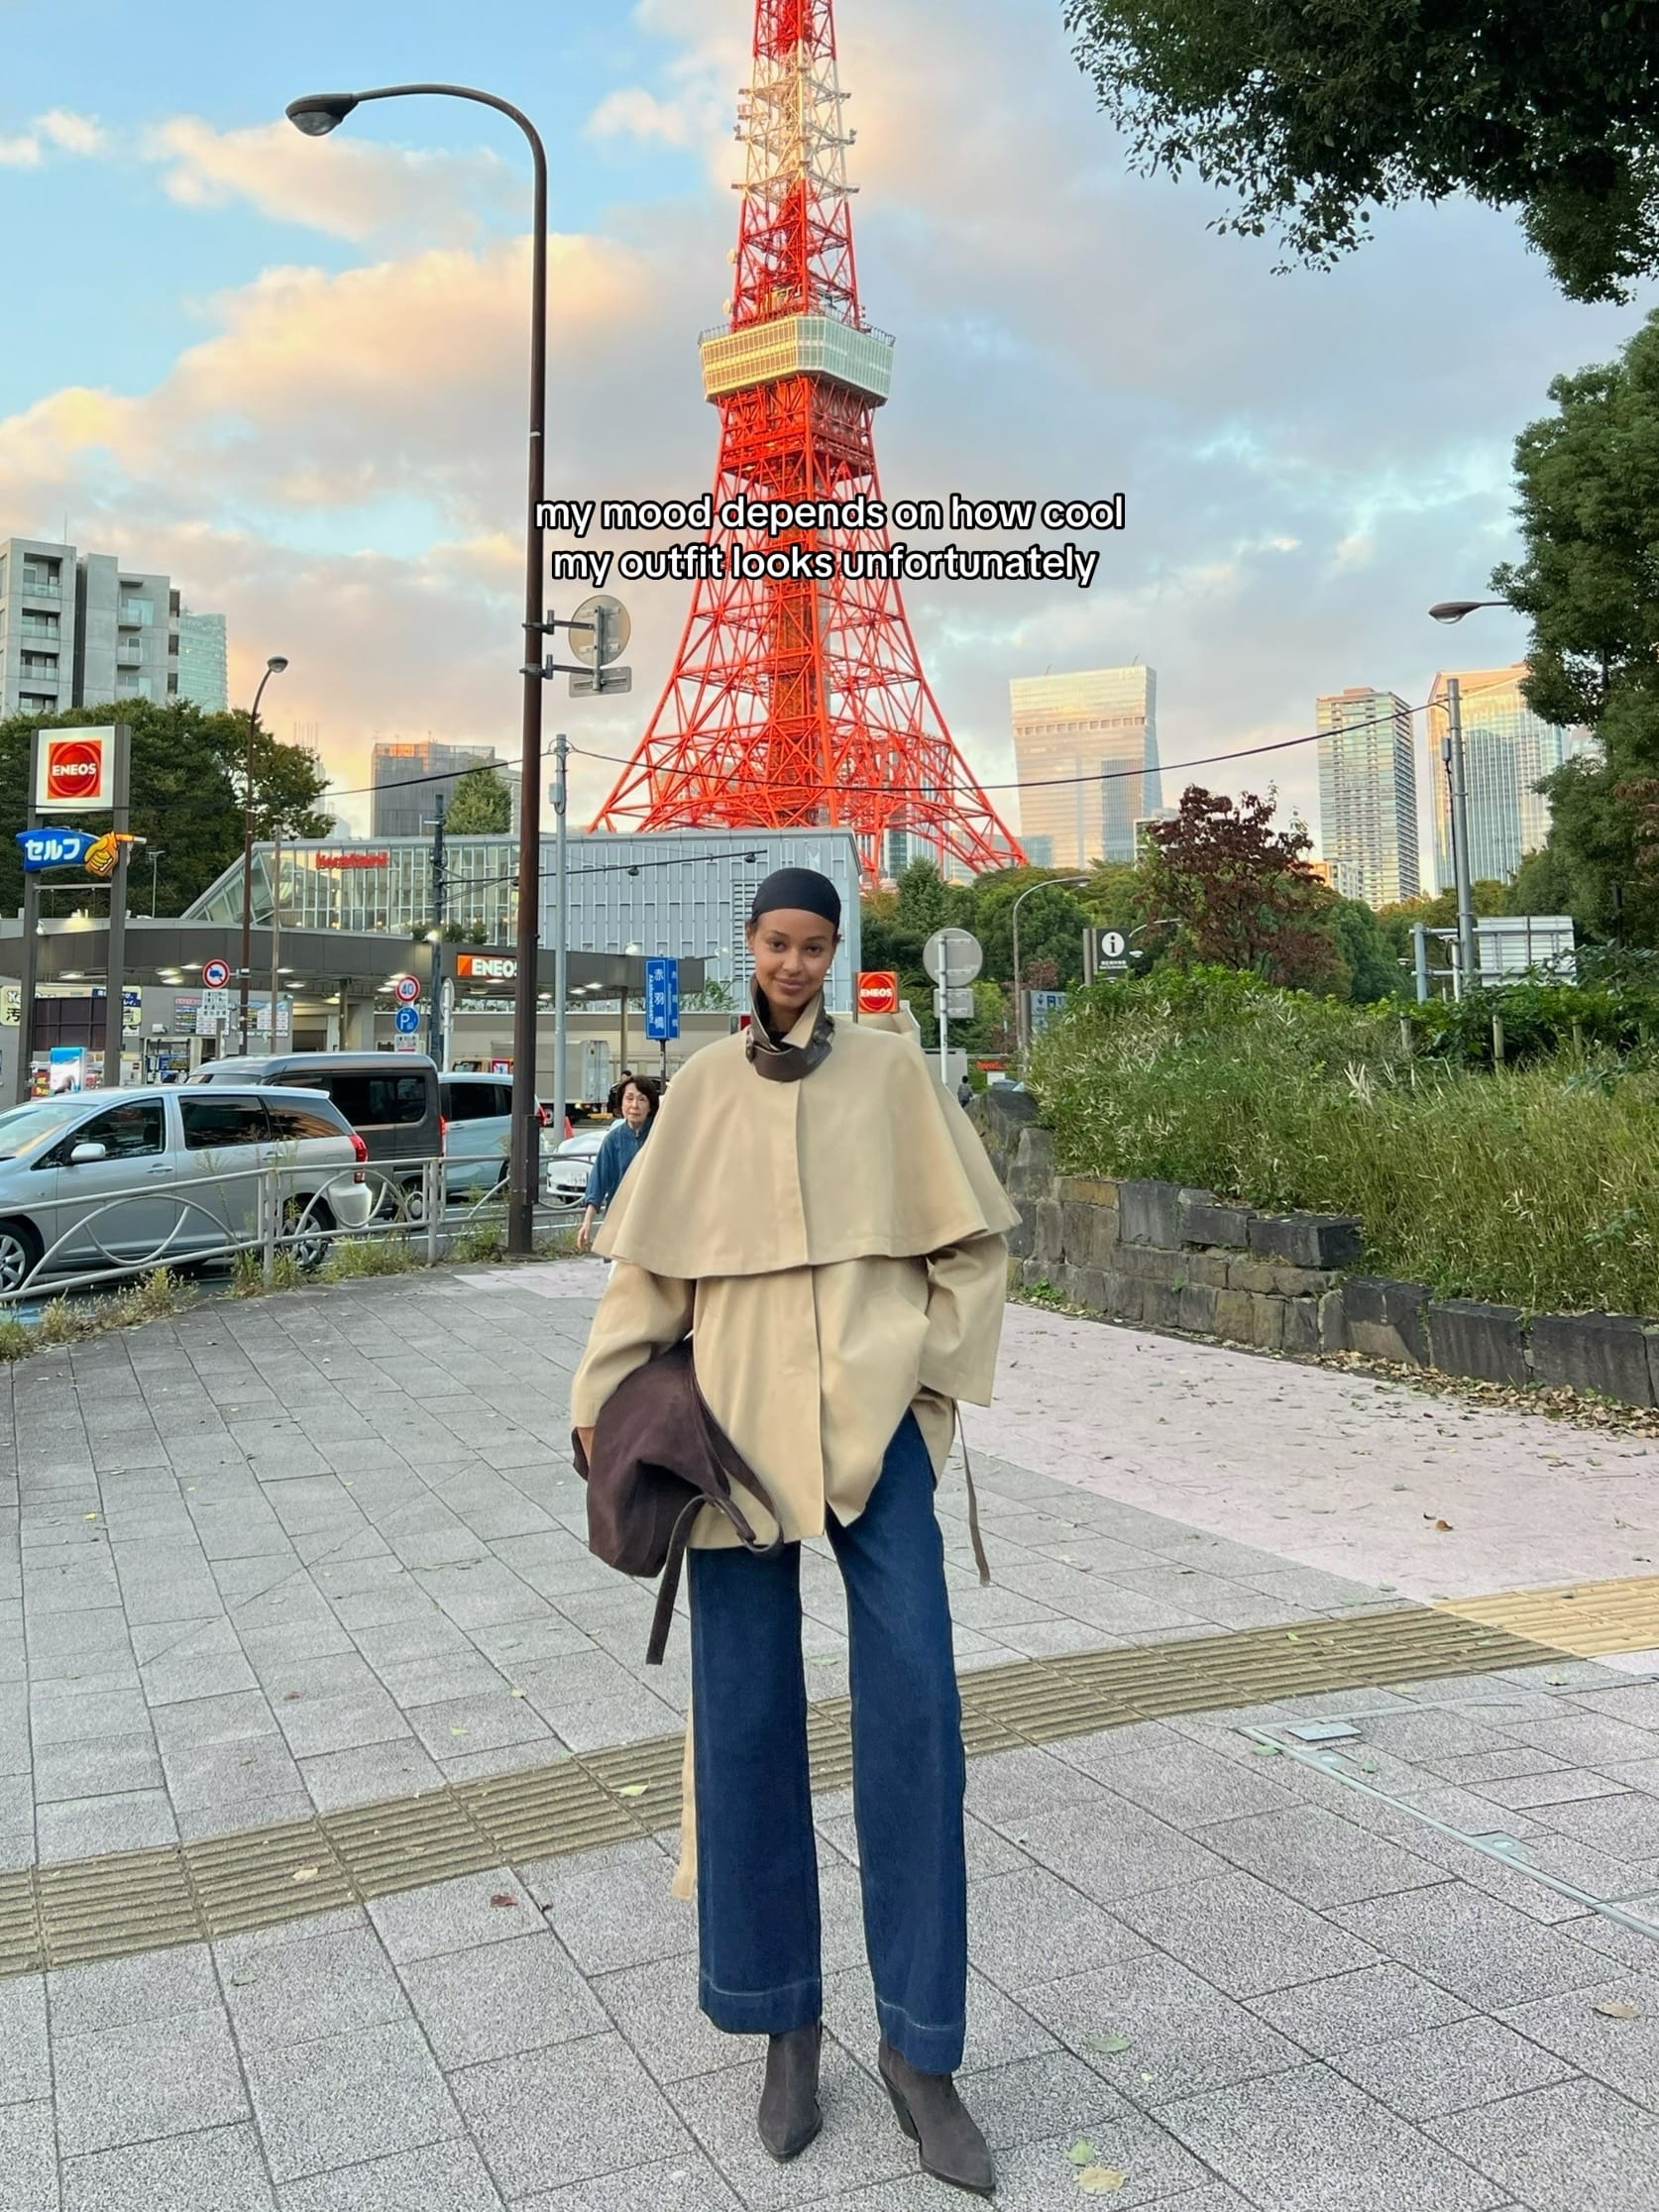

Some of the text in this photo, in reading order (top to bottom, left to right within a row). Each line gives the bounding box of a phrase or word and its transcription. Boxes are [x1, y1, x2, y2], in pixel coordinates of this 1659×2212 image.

[52, 763, 96, 777] ENEOS
[25, 838, 80, 861] セルフ
[400, 983, 413, 995] 40
[860, 988, 892, 998] ENEOS
[653, 968, 665, 1030] 赤羽橋
[400, 1013, 411, 1030] P
